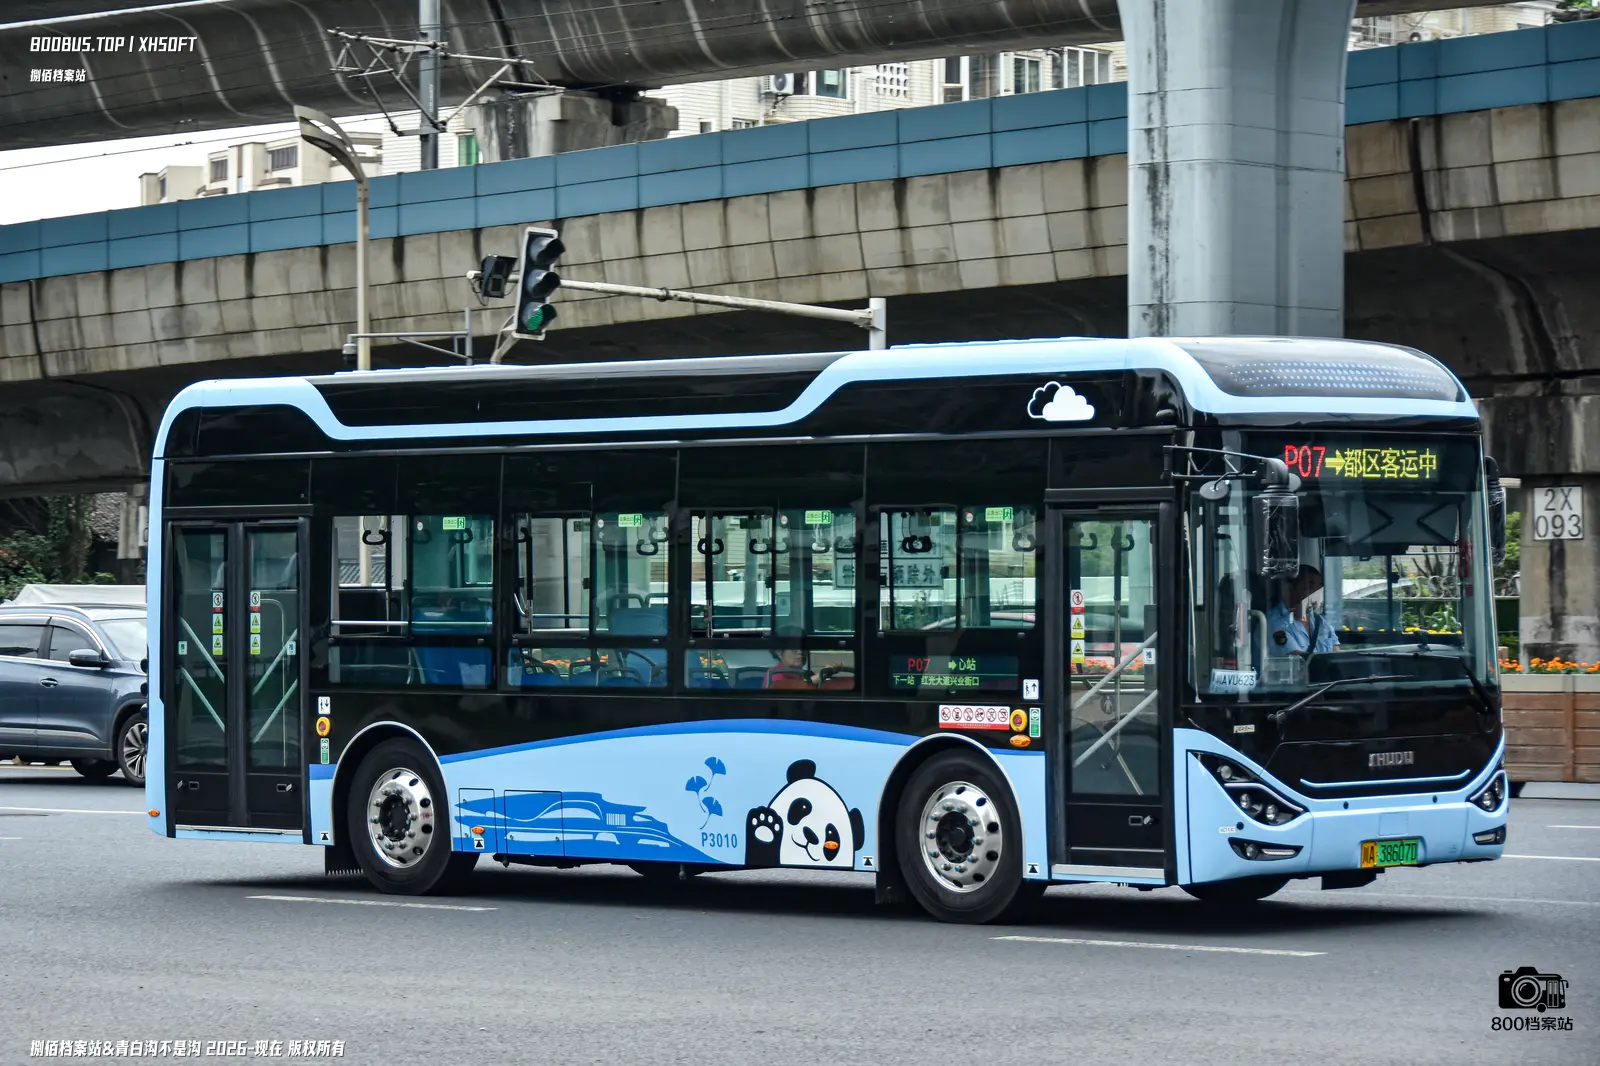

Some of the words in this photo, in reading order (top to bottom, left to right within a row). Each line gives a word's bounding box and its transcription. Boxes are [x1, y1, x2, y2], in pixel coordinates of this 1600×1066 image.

[1284, 444, 1326, 478] P07
[1344, 448, 1437, 479] 都区客运中
[1544, 488, 1573, 511] 2X
[1535, 514, 1581, 538] 093
[908, 658, 931, 672] P07
[893, 675, 915, 685] 下一站
[701, 832, 738, 848] P3010
